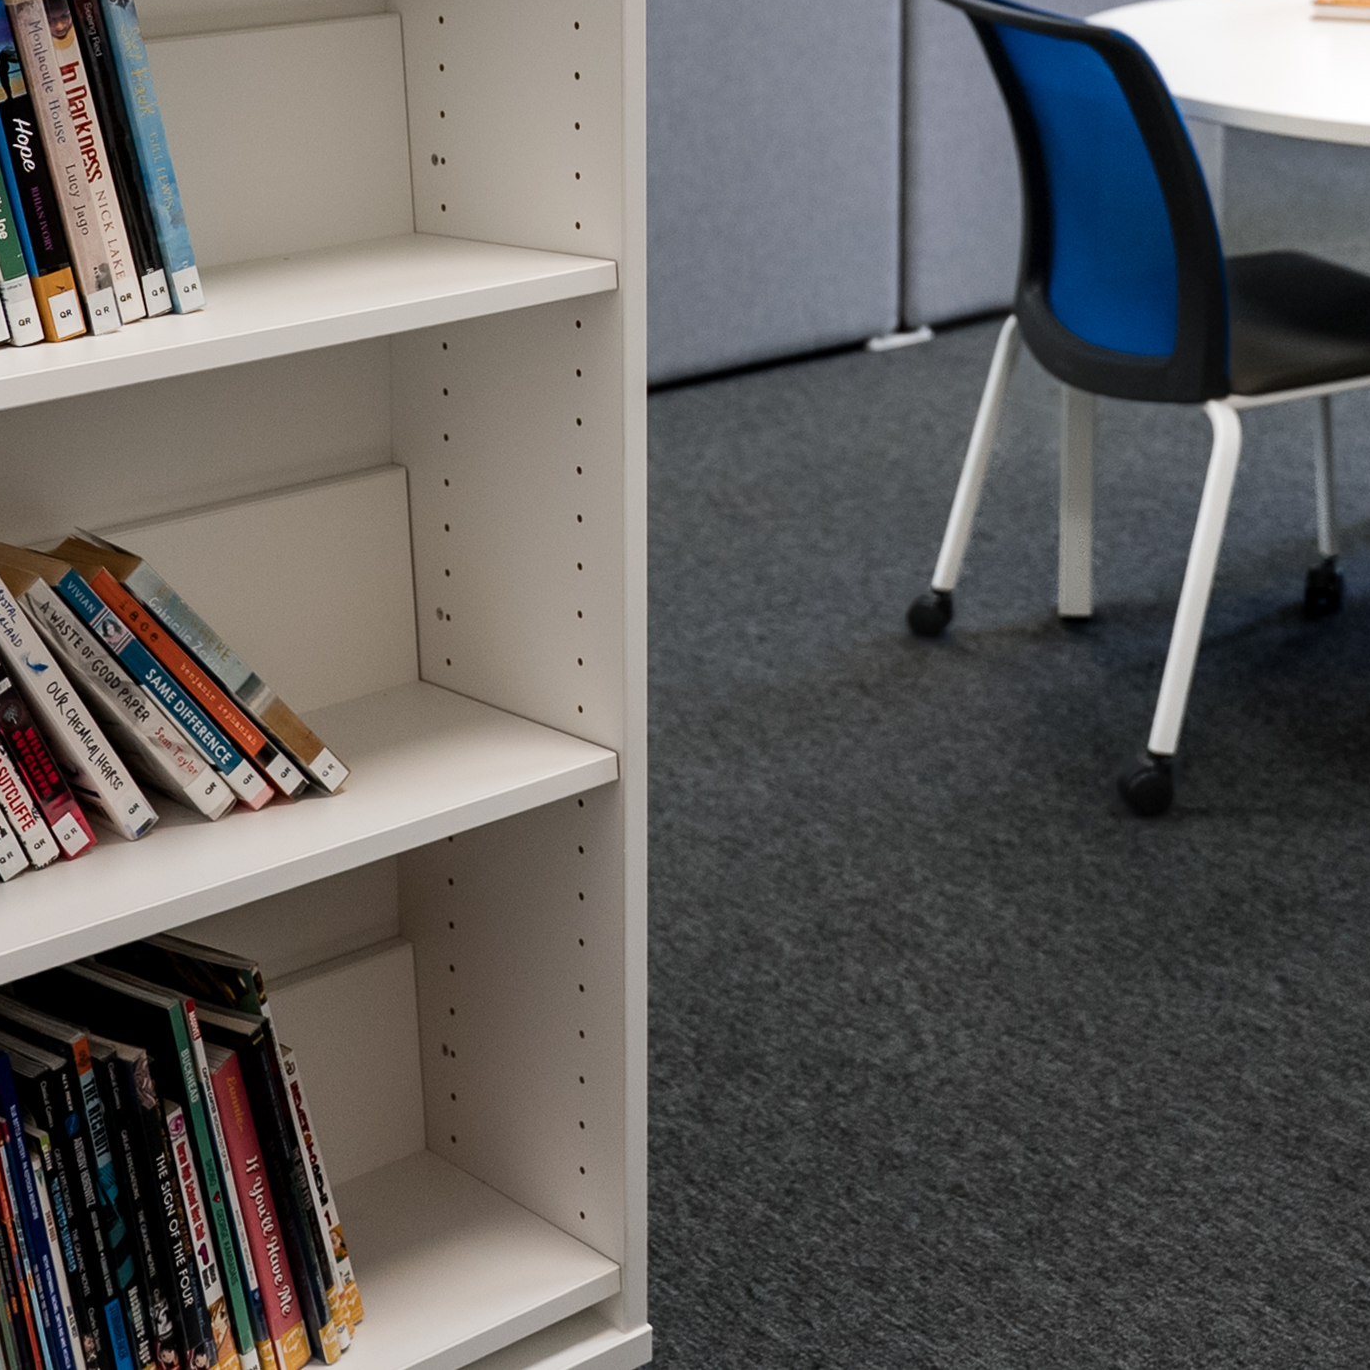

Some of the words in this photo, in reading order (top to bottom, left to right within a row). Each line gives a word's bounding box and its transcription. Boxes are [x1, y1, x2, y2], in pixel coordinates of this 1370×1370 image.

[59, 61, 79, 84] In
[49, 100, 66, 144] House
[66, 84, 102, 184] Darkness
[13, 118, 36, 173] Hope
[95, 190, 115, 232] NICK
[108, 238, 126, 279] LAKE
[59, 309, 72, 319] QR
[49, 611, 83, 649] WASTE
[82, 643, 95, 658] OF
[90, 651, 122, 690] GOOD
[116, 685, 152, 723] PAPER
[45, 681, 69, 712] OUR
[65, 706, 102, 765] CHEMICAL
[92, 754, 124, 792] HEARTS
[145, 668, 178, 704] SAME
[173, 700, 233, 765] DIFFERENCE
[205, 782, 217, 795] QR
[181, 1048, 199, 1103] BUCKHEAD
[155, 1152, 168, 1179] THE
[160, 1182, 175, 1217] SIGN
[169, 1219, 180, 1238] OF
[248, 1176, 275, 1237] You'll
[266, 1236, 284, 1287] Have
[278, 1285, 293, 1318] Me
[172, 1240, 186, 1267] THE
[179, 1269, 194, 1308] FOUR
